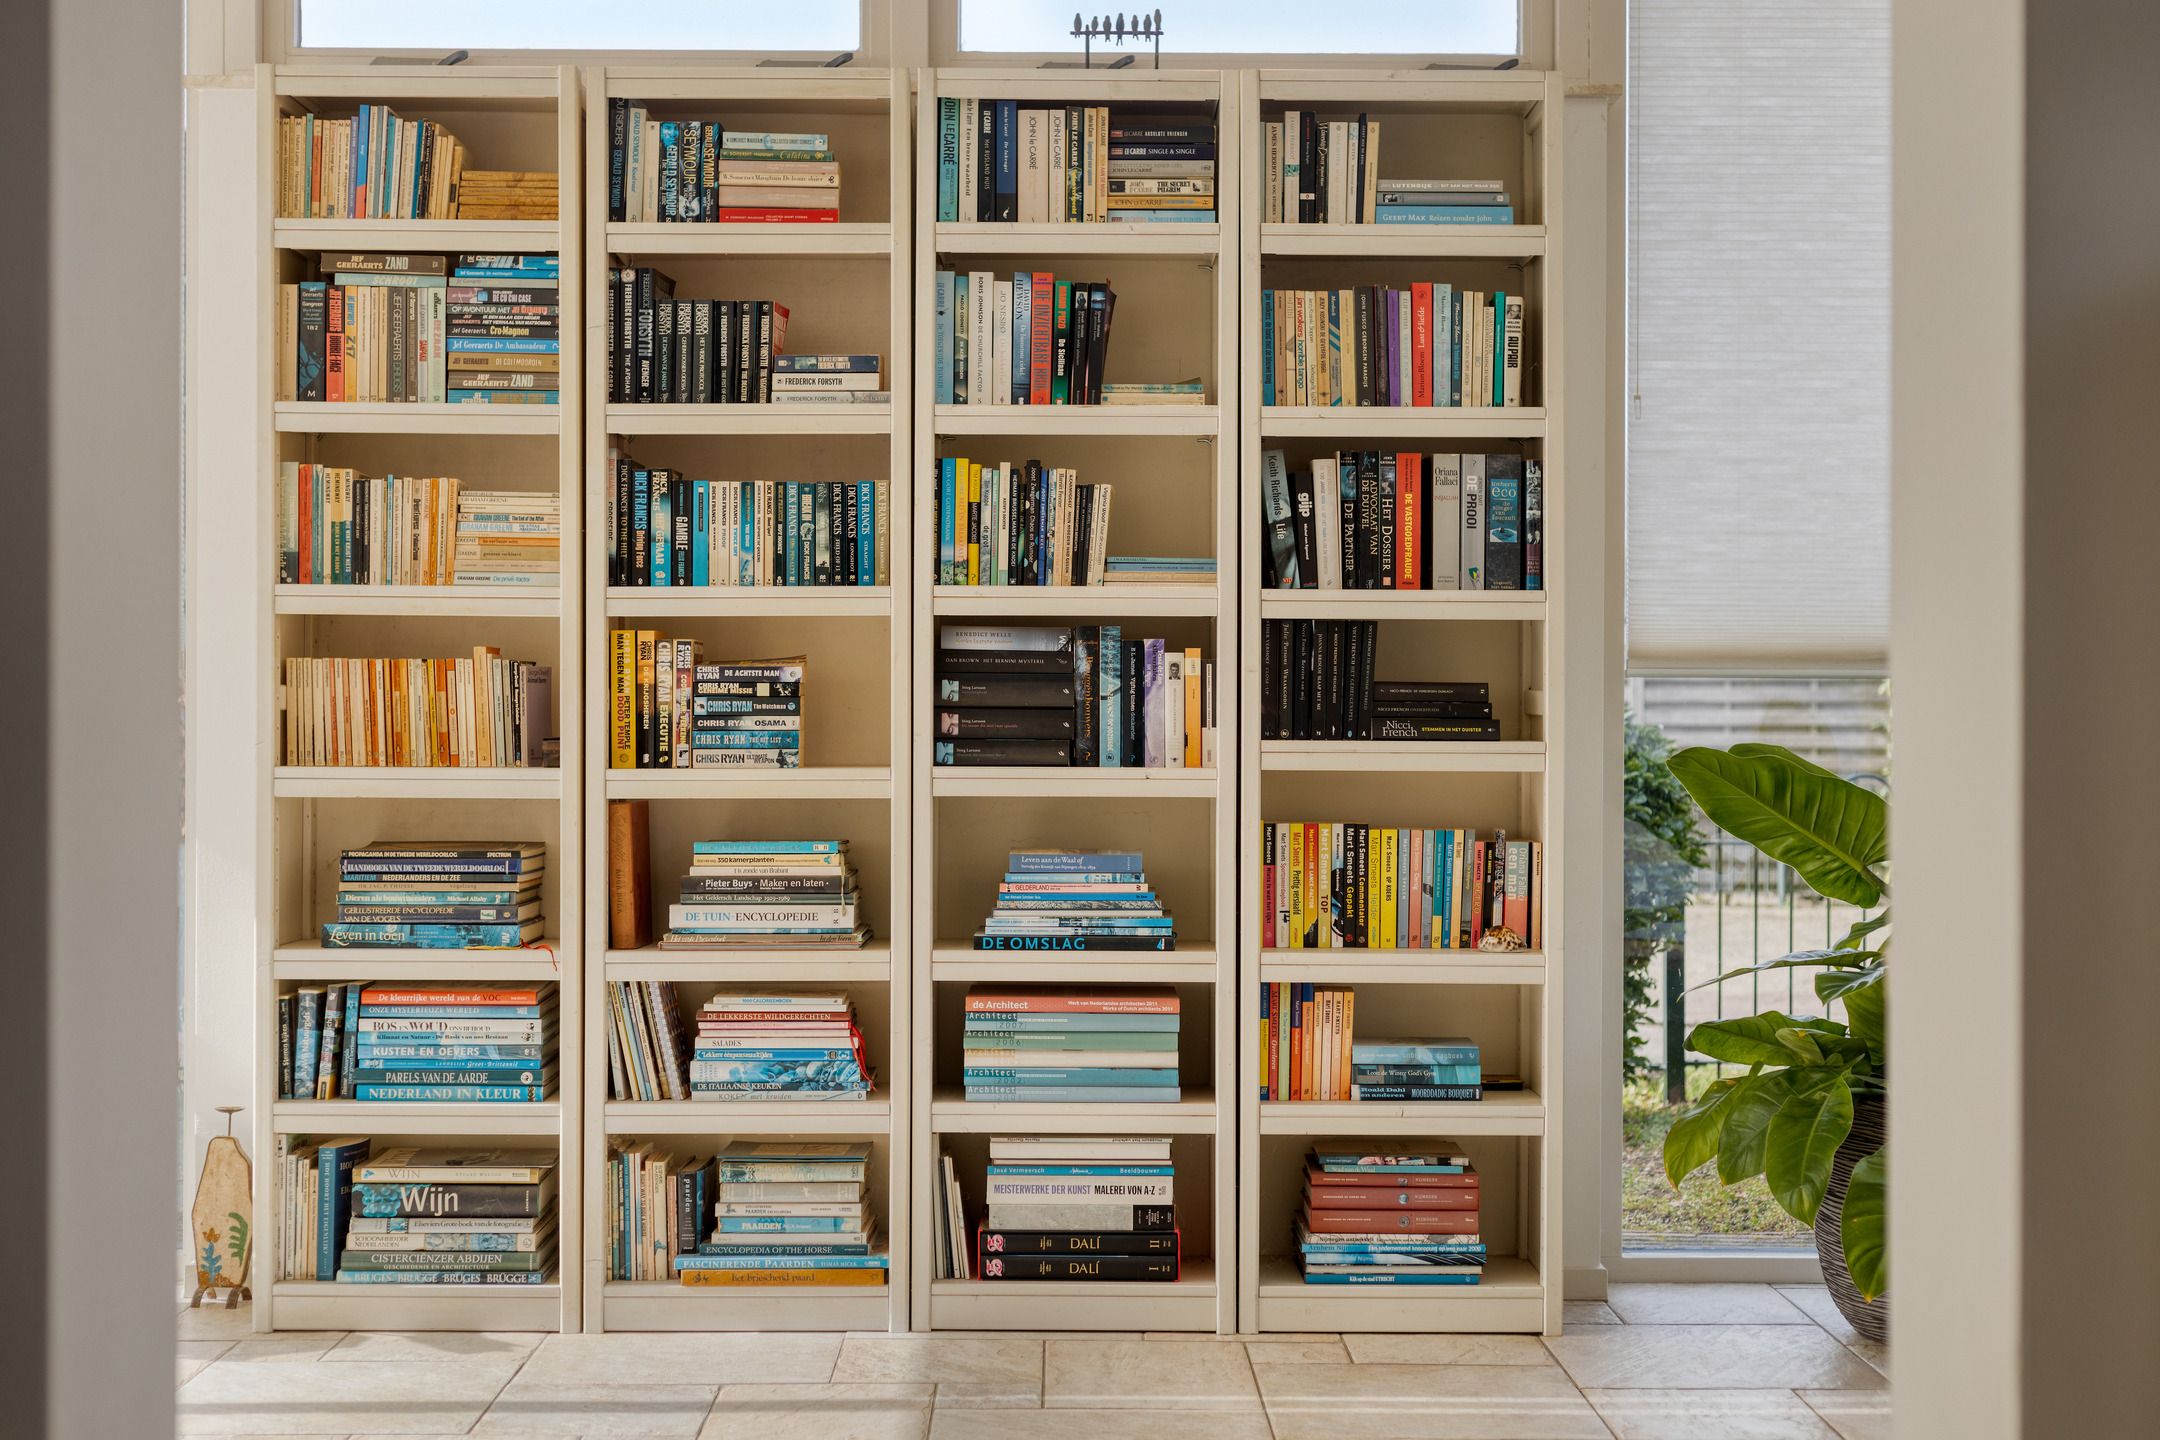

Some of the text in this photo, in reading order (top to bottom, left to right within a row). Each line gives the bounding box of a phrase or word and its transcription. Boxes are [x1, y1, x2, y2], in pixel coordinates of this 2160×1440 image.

[684, 129, 696, 184] SEYMOUR
[1054, 146, 1062, 170] CARRÉ
[704, 148, 714, 187] SEYMOUR
[385, 257, 408, 270] ZAND
[372, 276, 417, 285] SCHROOT
[1296, 298, 1304, 309] jan
[490, 326, 529, 336] Cro-Magnon
[638, 309, 652, 356] FORSYTH
[330, 336, 341, 373] DOUBLE-FACE
[393, 362, 401, 392] DRUGS
[862, 484, 870, 501] DICK
[1362, 480, 1369, 492] DE
[1268, 456, 1286, 539] Keith Richards Life
[1492, 488, 1516, 498] eco
[1298, 493, 1312, 517] gijp
[1467, 475, 1477, 529] DE PROOI
[634, 472, 647, 568] DICK FRANCIS Driving Force
[862, 504, 870, 534] FRANCIS
[676, 516, 688, 550] GAMBLE
[983, 526, 989, 534] de
[1404, 494, 1412, 579] DE VASTGOEDFRAUDE
[708, 701, 752, 712] CHRIS RYAN
[660, 705, 668, 751] EXECUTIE
[1386, 720, 1411, 729] Nicci
[1383, 727, 1418, 737] French
[1508, 848, 1517, 900] een man
[1518, 848, 1526, 901] Oriana Fallaci
[733, 880, 753, 889] Buys
[685, 912, 819, 921] DE TUIN ENCYCLOPEDIE
[330, 925, 404, 946] Leven in toen
[983, 938, 1085, 950] DE OMSLAG
[391, 994, 427, 1002] kleurrijke
[973, 1001, 1029, 1009] de Architect
[373, 1048, 479, 1056] KUSTEN EN OEVERS
[386, 1073, 488, 1083] PARELS VAN DE AARDE
[369, 1088, 520, 1098] NEDERLAND IN KLEUR
[388, 1169, 420, 1178] WIJN
[994, 1185, 1155, 1195] MEISTERWERKE DER KUNST MALEREI VON A-Z
[400, 1186, 458, 1216] Wijn
[1070, 1236, 1101, 1249] DALÍ
[706, 1246, 770, 1254] ENCYCLOPEDIA
[803, 1246, 833, 1254] HORSE
[1069, 1261, 1100, 1274] DALÍ
